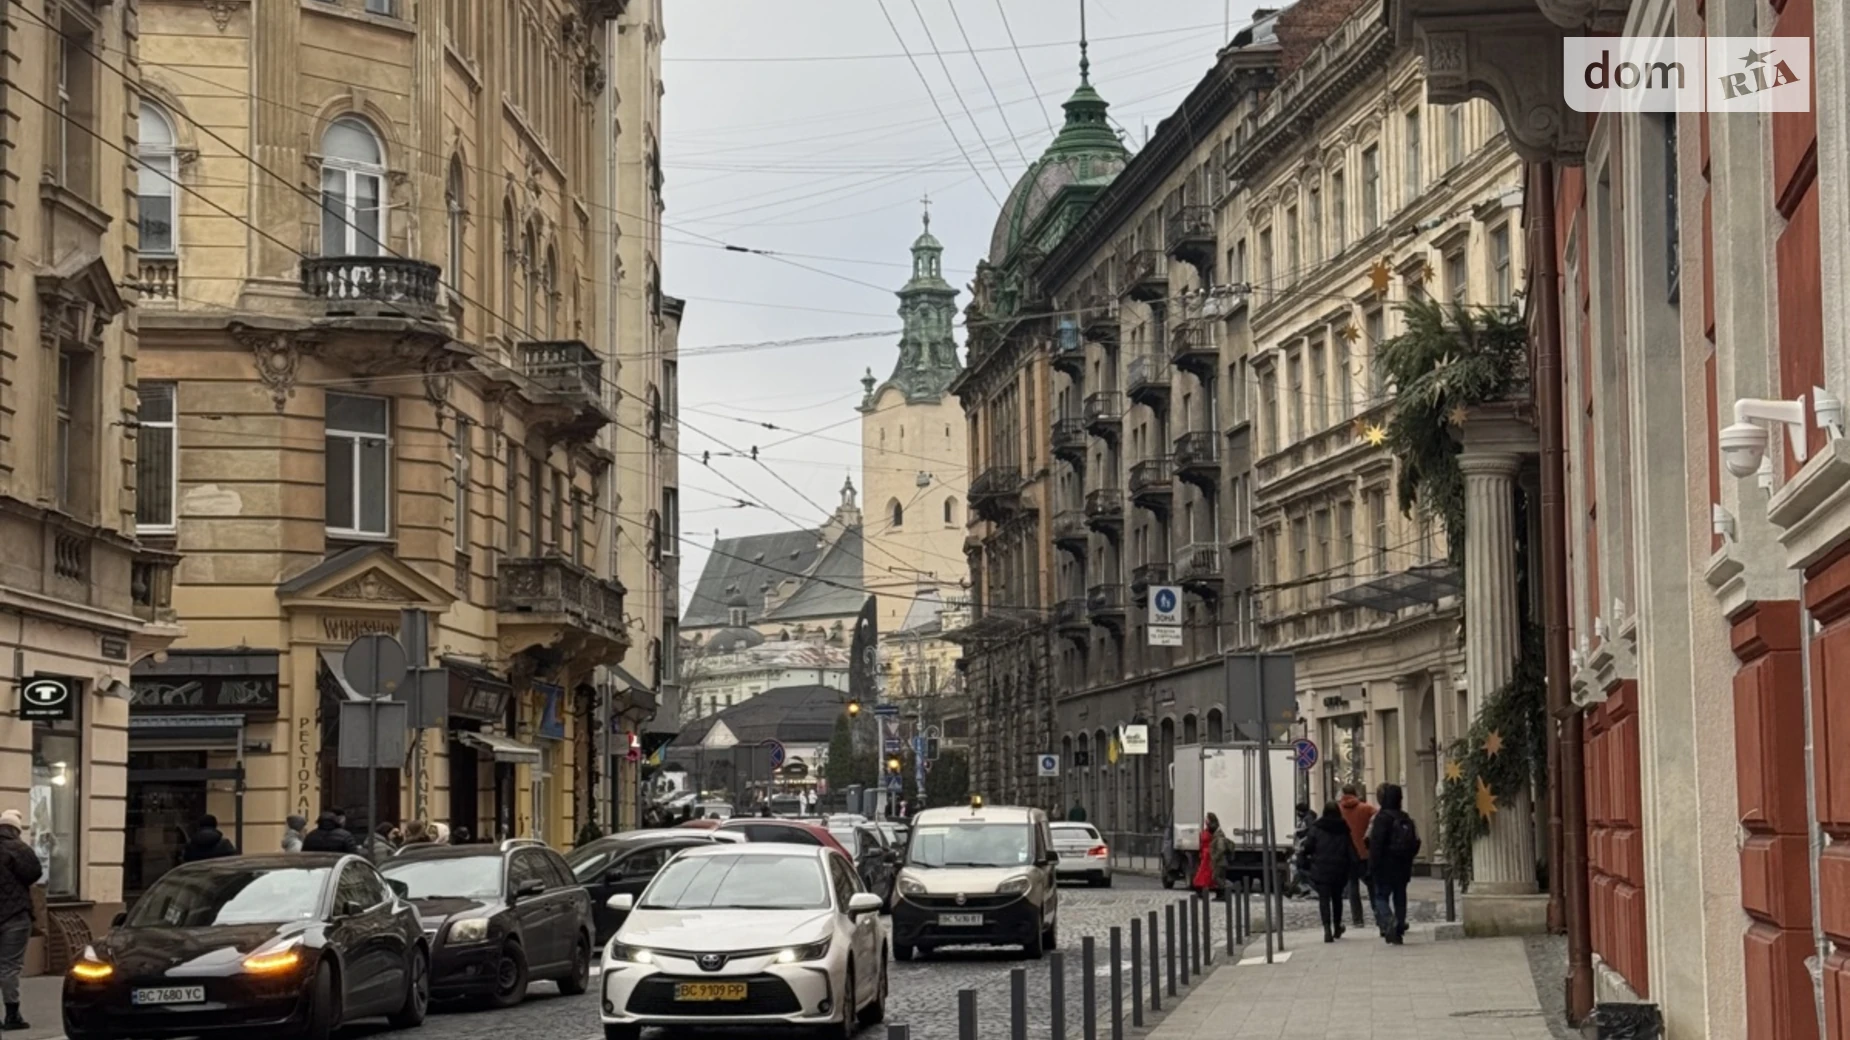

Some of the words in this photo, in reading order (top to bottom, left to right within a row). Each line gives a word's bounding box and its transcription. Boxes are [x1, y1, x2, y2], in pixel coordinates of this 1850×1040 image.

[1155, 613, 1175, 622] ЗОНА
[139, 990, 155, 1001] BC
[156, 989, 183, 1001] 7680
[185, 988, 201, 1000] YC
[681, 985, 697, 997] BC
[728, 985, 744, 997] PP
